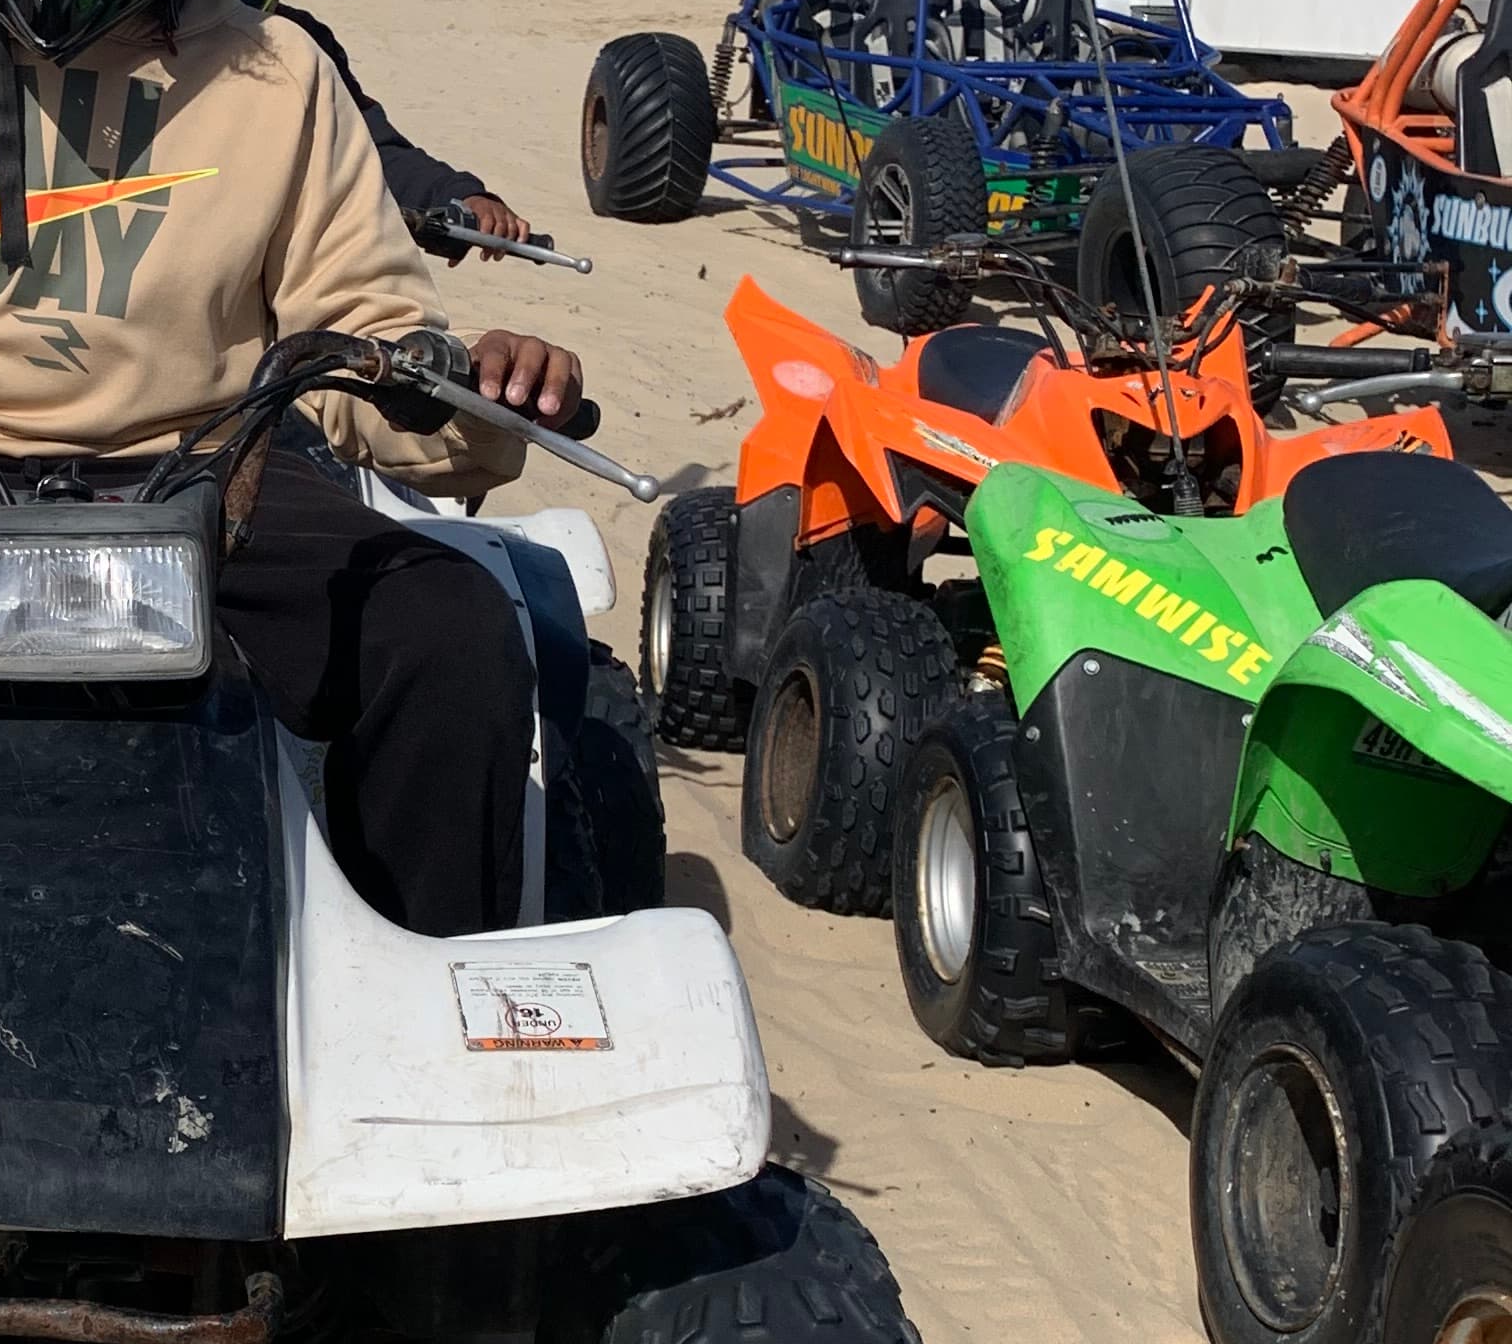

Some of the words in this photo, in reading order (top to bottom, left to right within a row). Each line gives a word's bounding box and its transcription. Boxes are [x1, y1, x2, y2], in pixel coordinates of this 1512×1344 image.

[1431, 194, 1512, 251] SUNBU
[1024, 528, 1273, 685] SAMWISE
[519, 1008, 544, 1019] 16
[493, 1038, 565, 1048] WARNING
